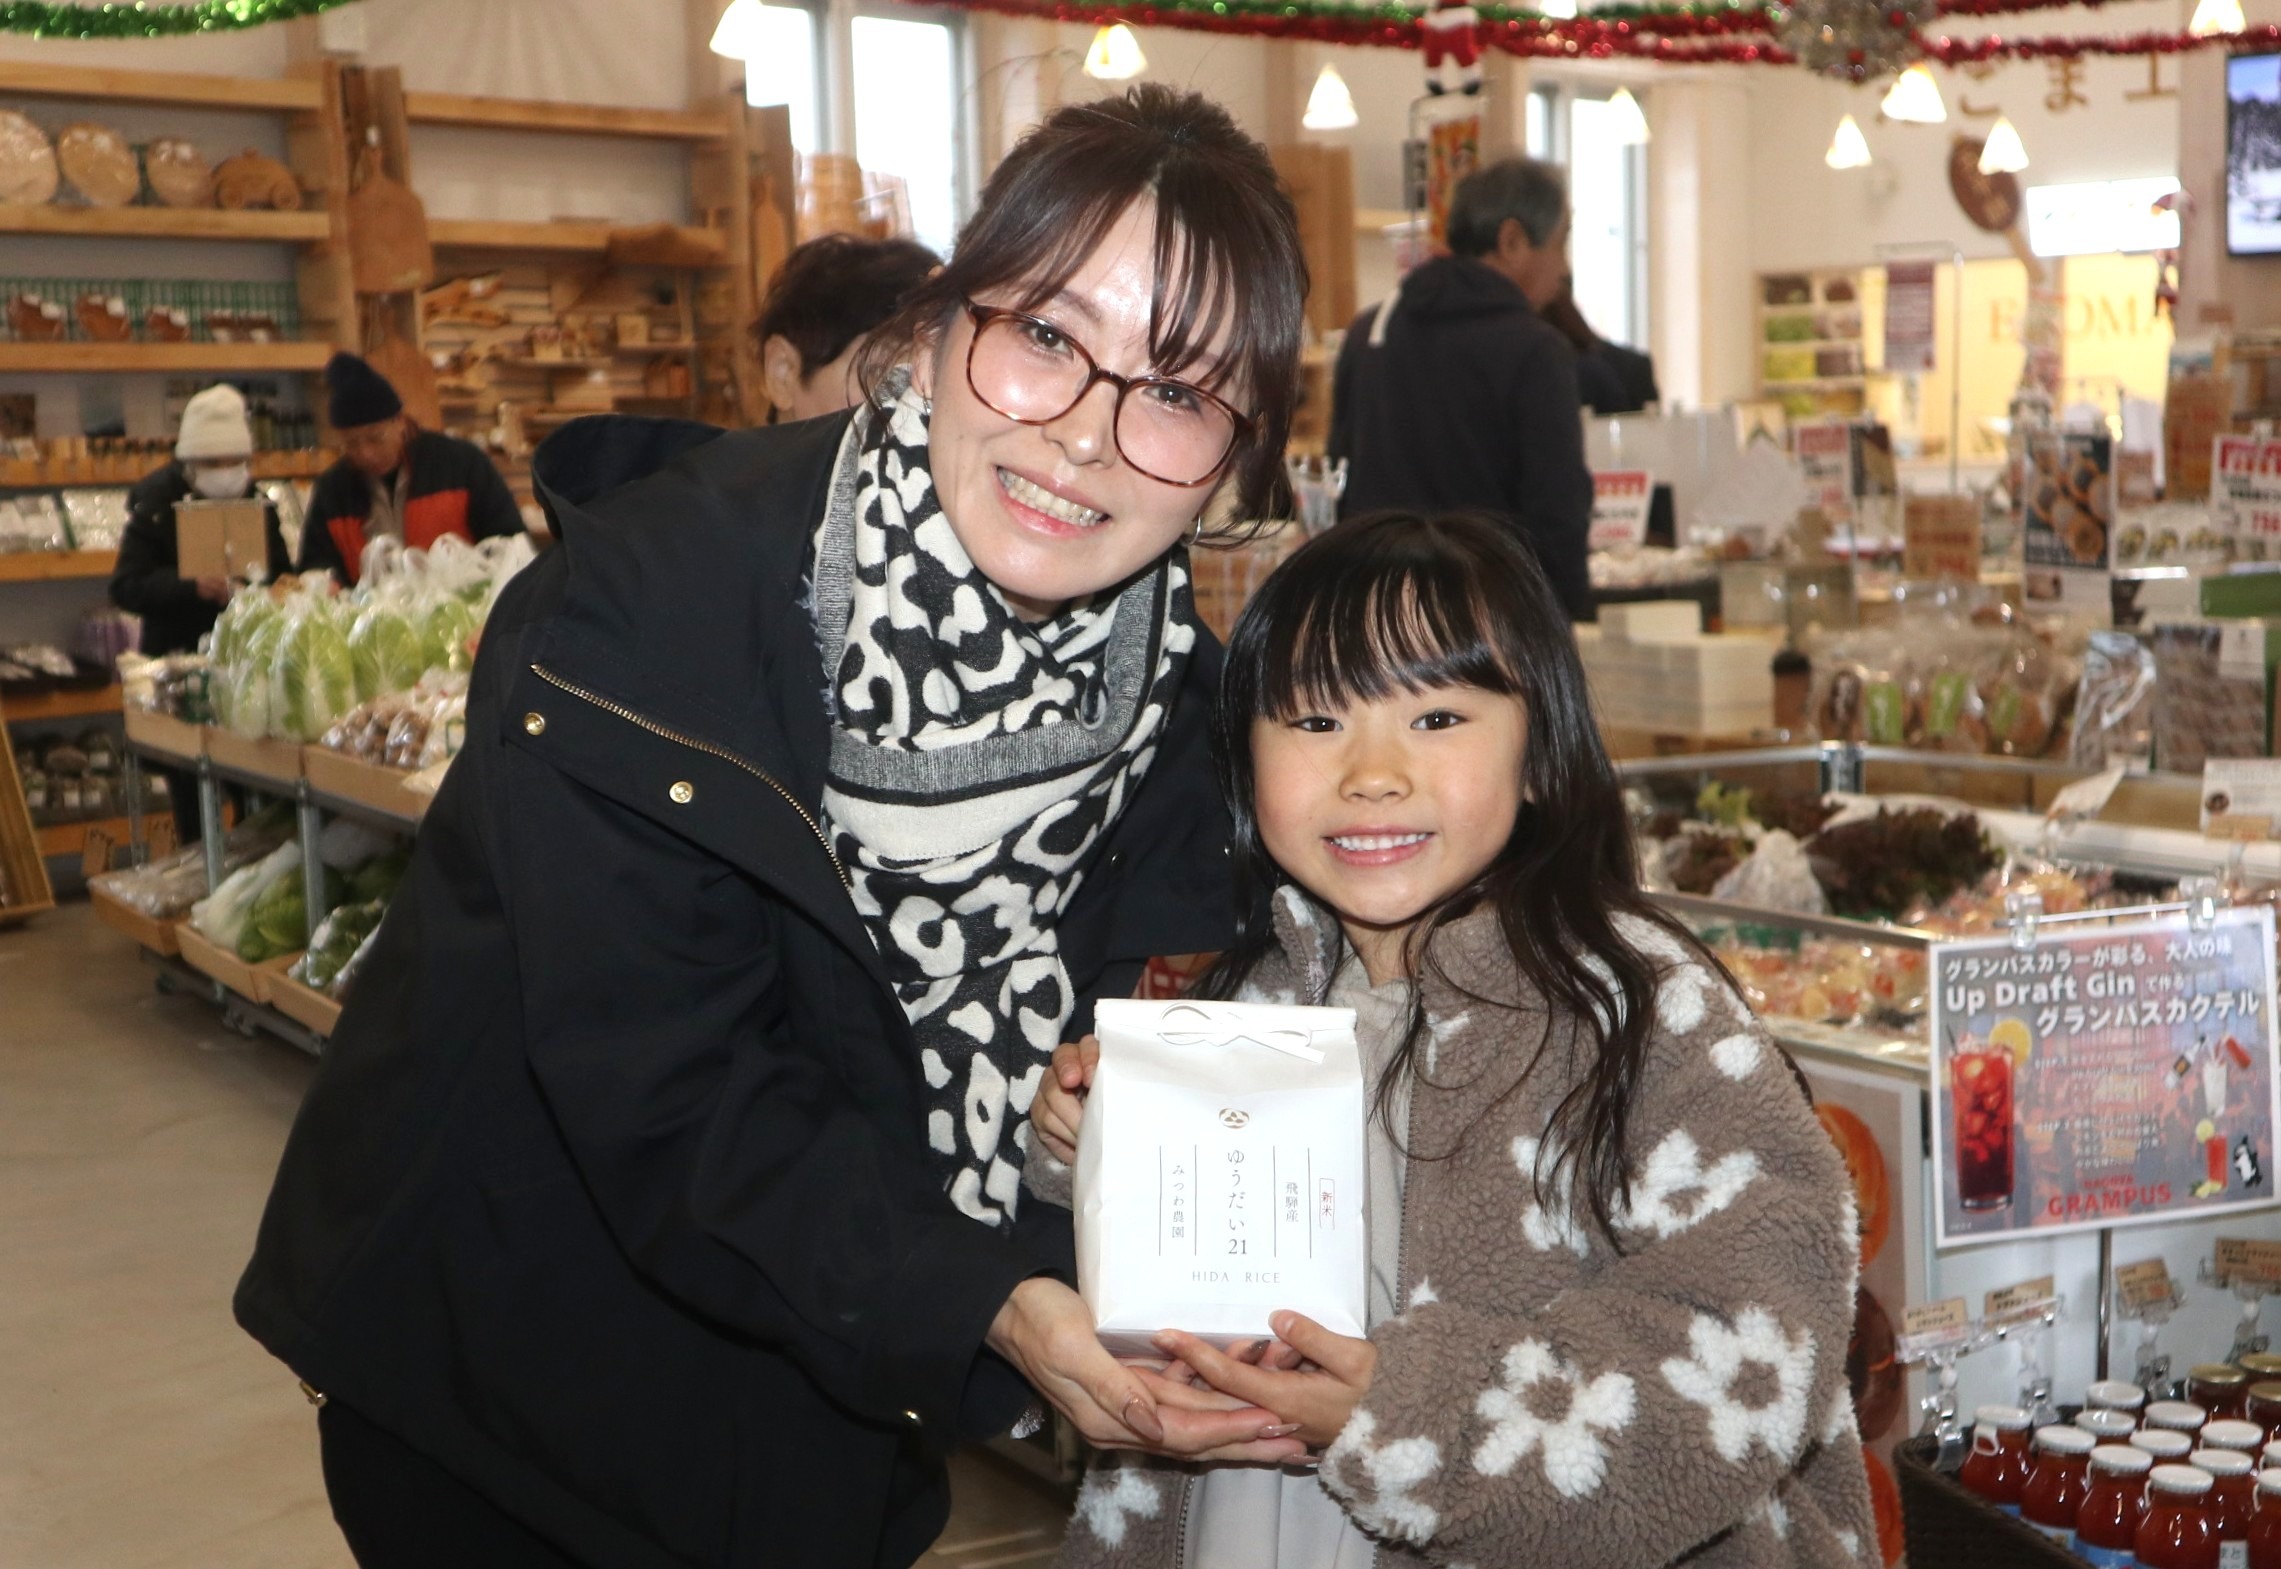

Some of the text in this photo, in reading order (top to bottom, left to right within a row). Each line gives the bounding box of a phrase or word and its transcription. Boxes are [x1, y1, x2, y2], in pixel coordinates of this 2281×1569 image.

[1946, 985, 1986, 1016] Up
[1995, 974, 2078, 1008] Draft
[2086, 971, 2135, 998] Gin
[1171, 1164, 1185, 1238] みつわ農園
[1285, 1181, 1298, 1222] 飛騨産
[1322, 1191, 1332, 1216] 新米
[2048, 1183, 2172, 1216] GRAMPUS
[1192, 1271, 1281, 1284] HIDA RICE
